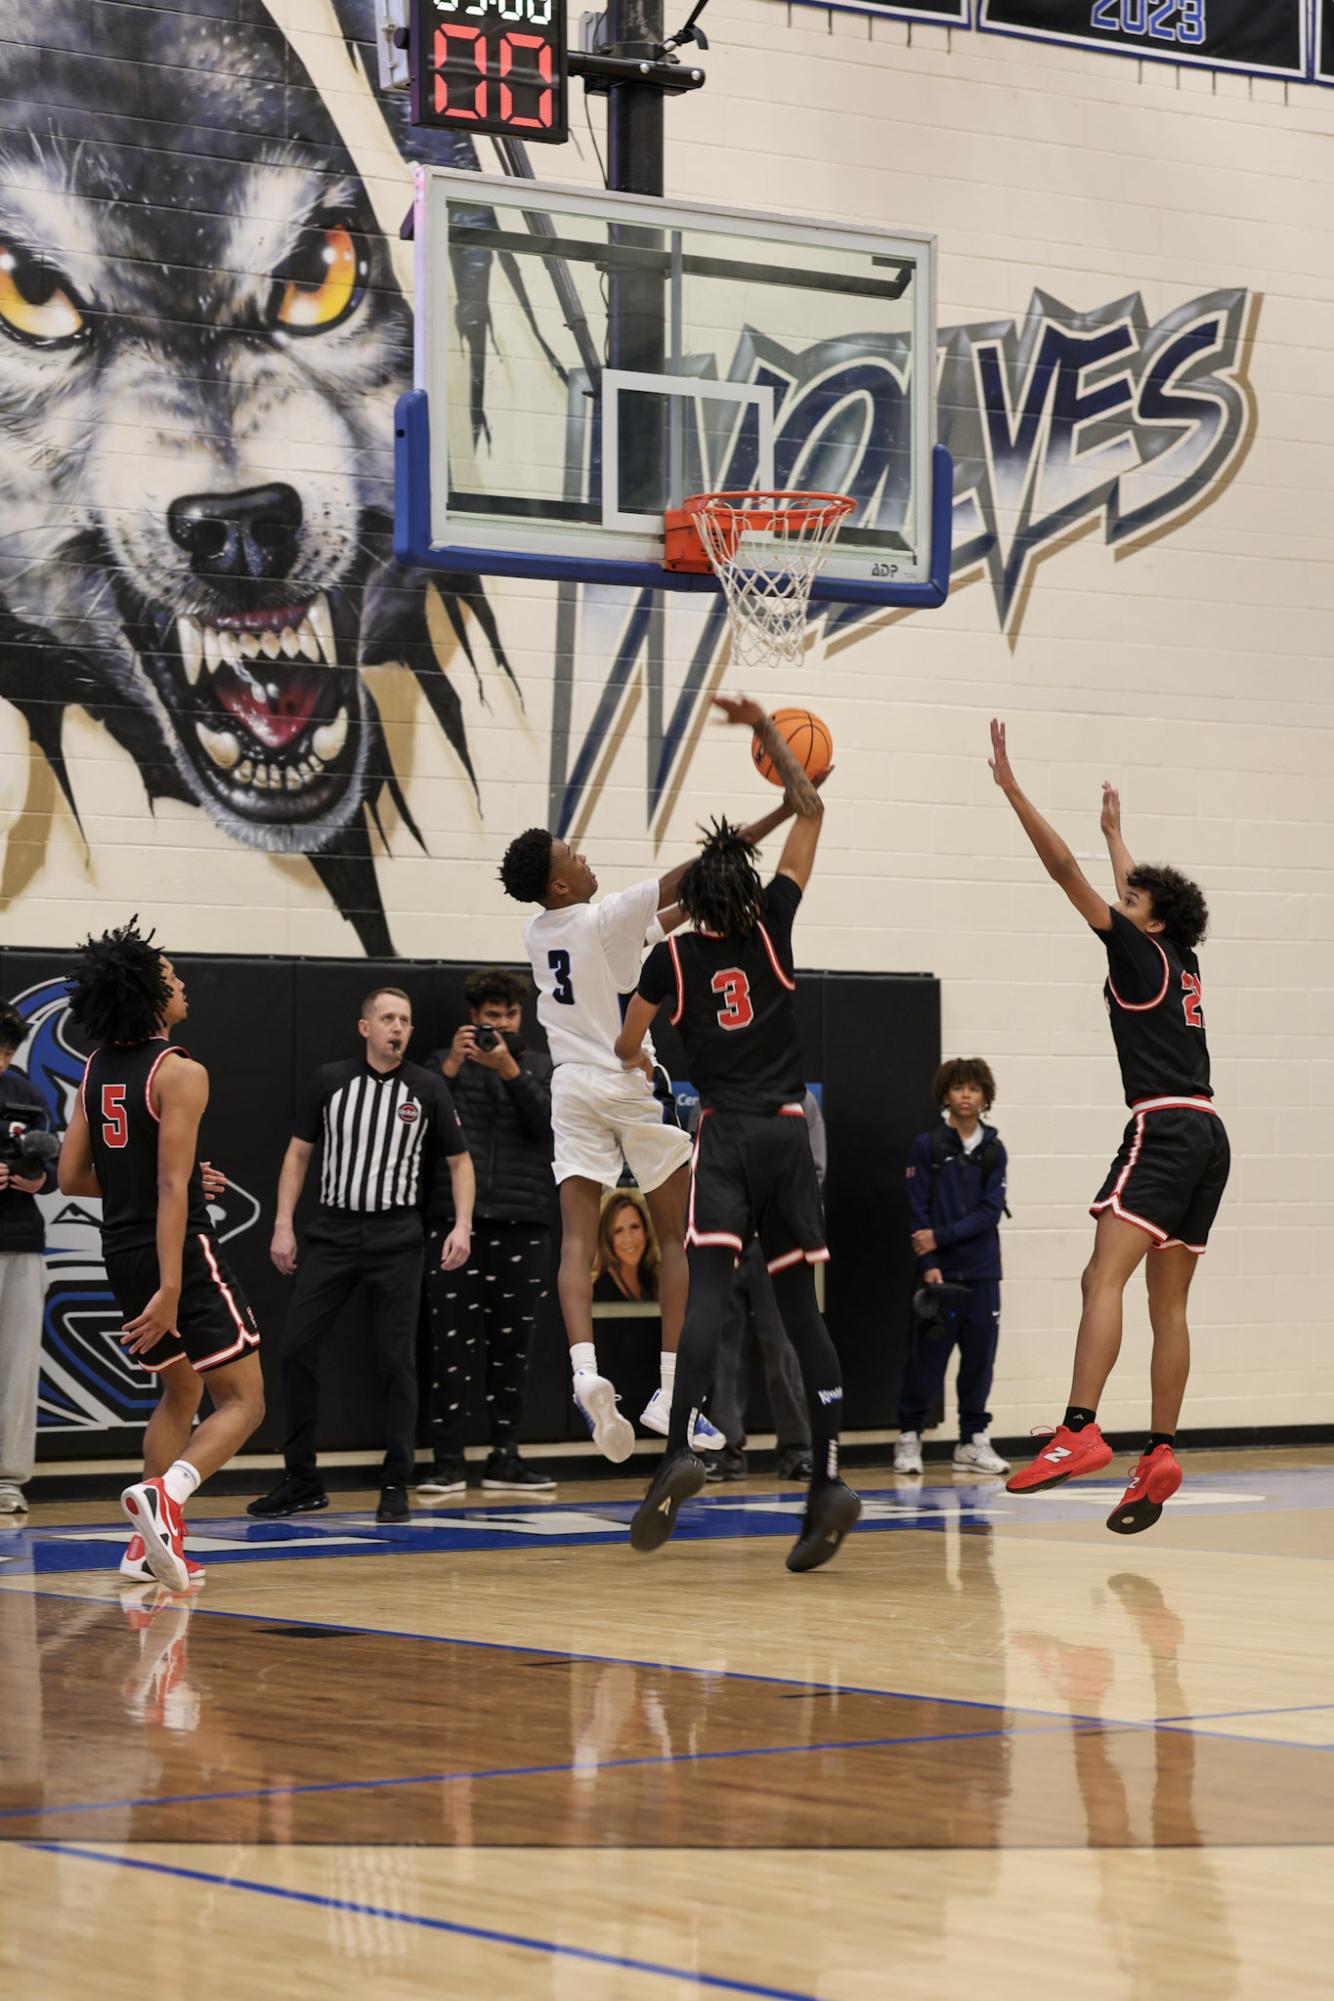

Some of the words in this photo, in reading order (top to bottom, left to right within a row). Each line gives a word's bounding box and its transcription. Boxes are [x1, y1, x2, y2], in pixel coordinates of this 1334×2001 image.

[1090, 0, 1206, 45] 2023
[433, 23, 553, 128] 00
[548, 949, 576, 1006] 3
[711, 966, 755, 1032] 3
[101, 1083, 129, 1149] 5
